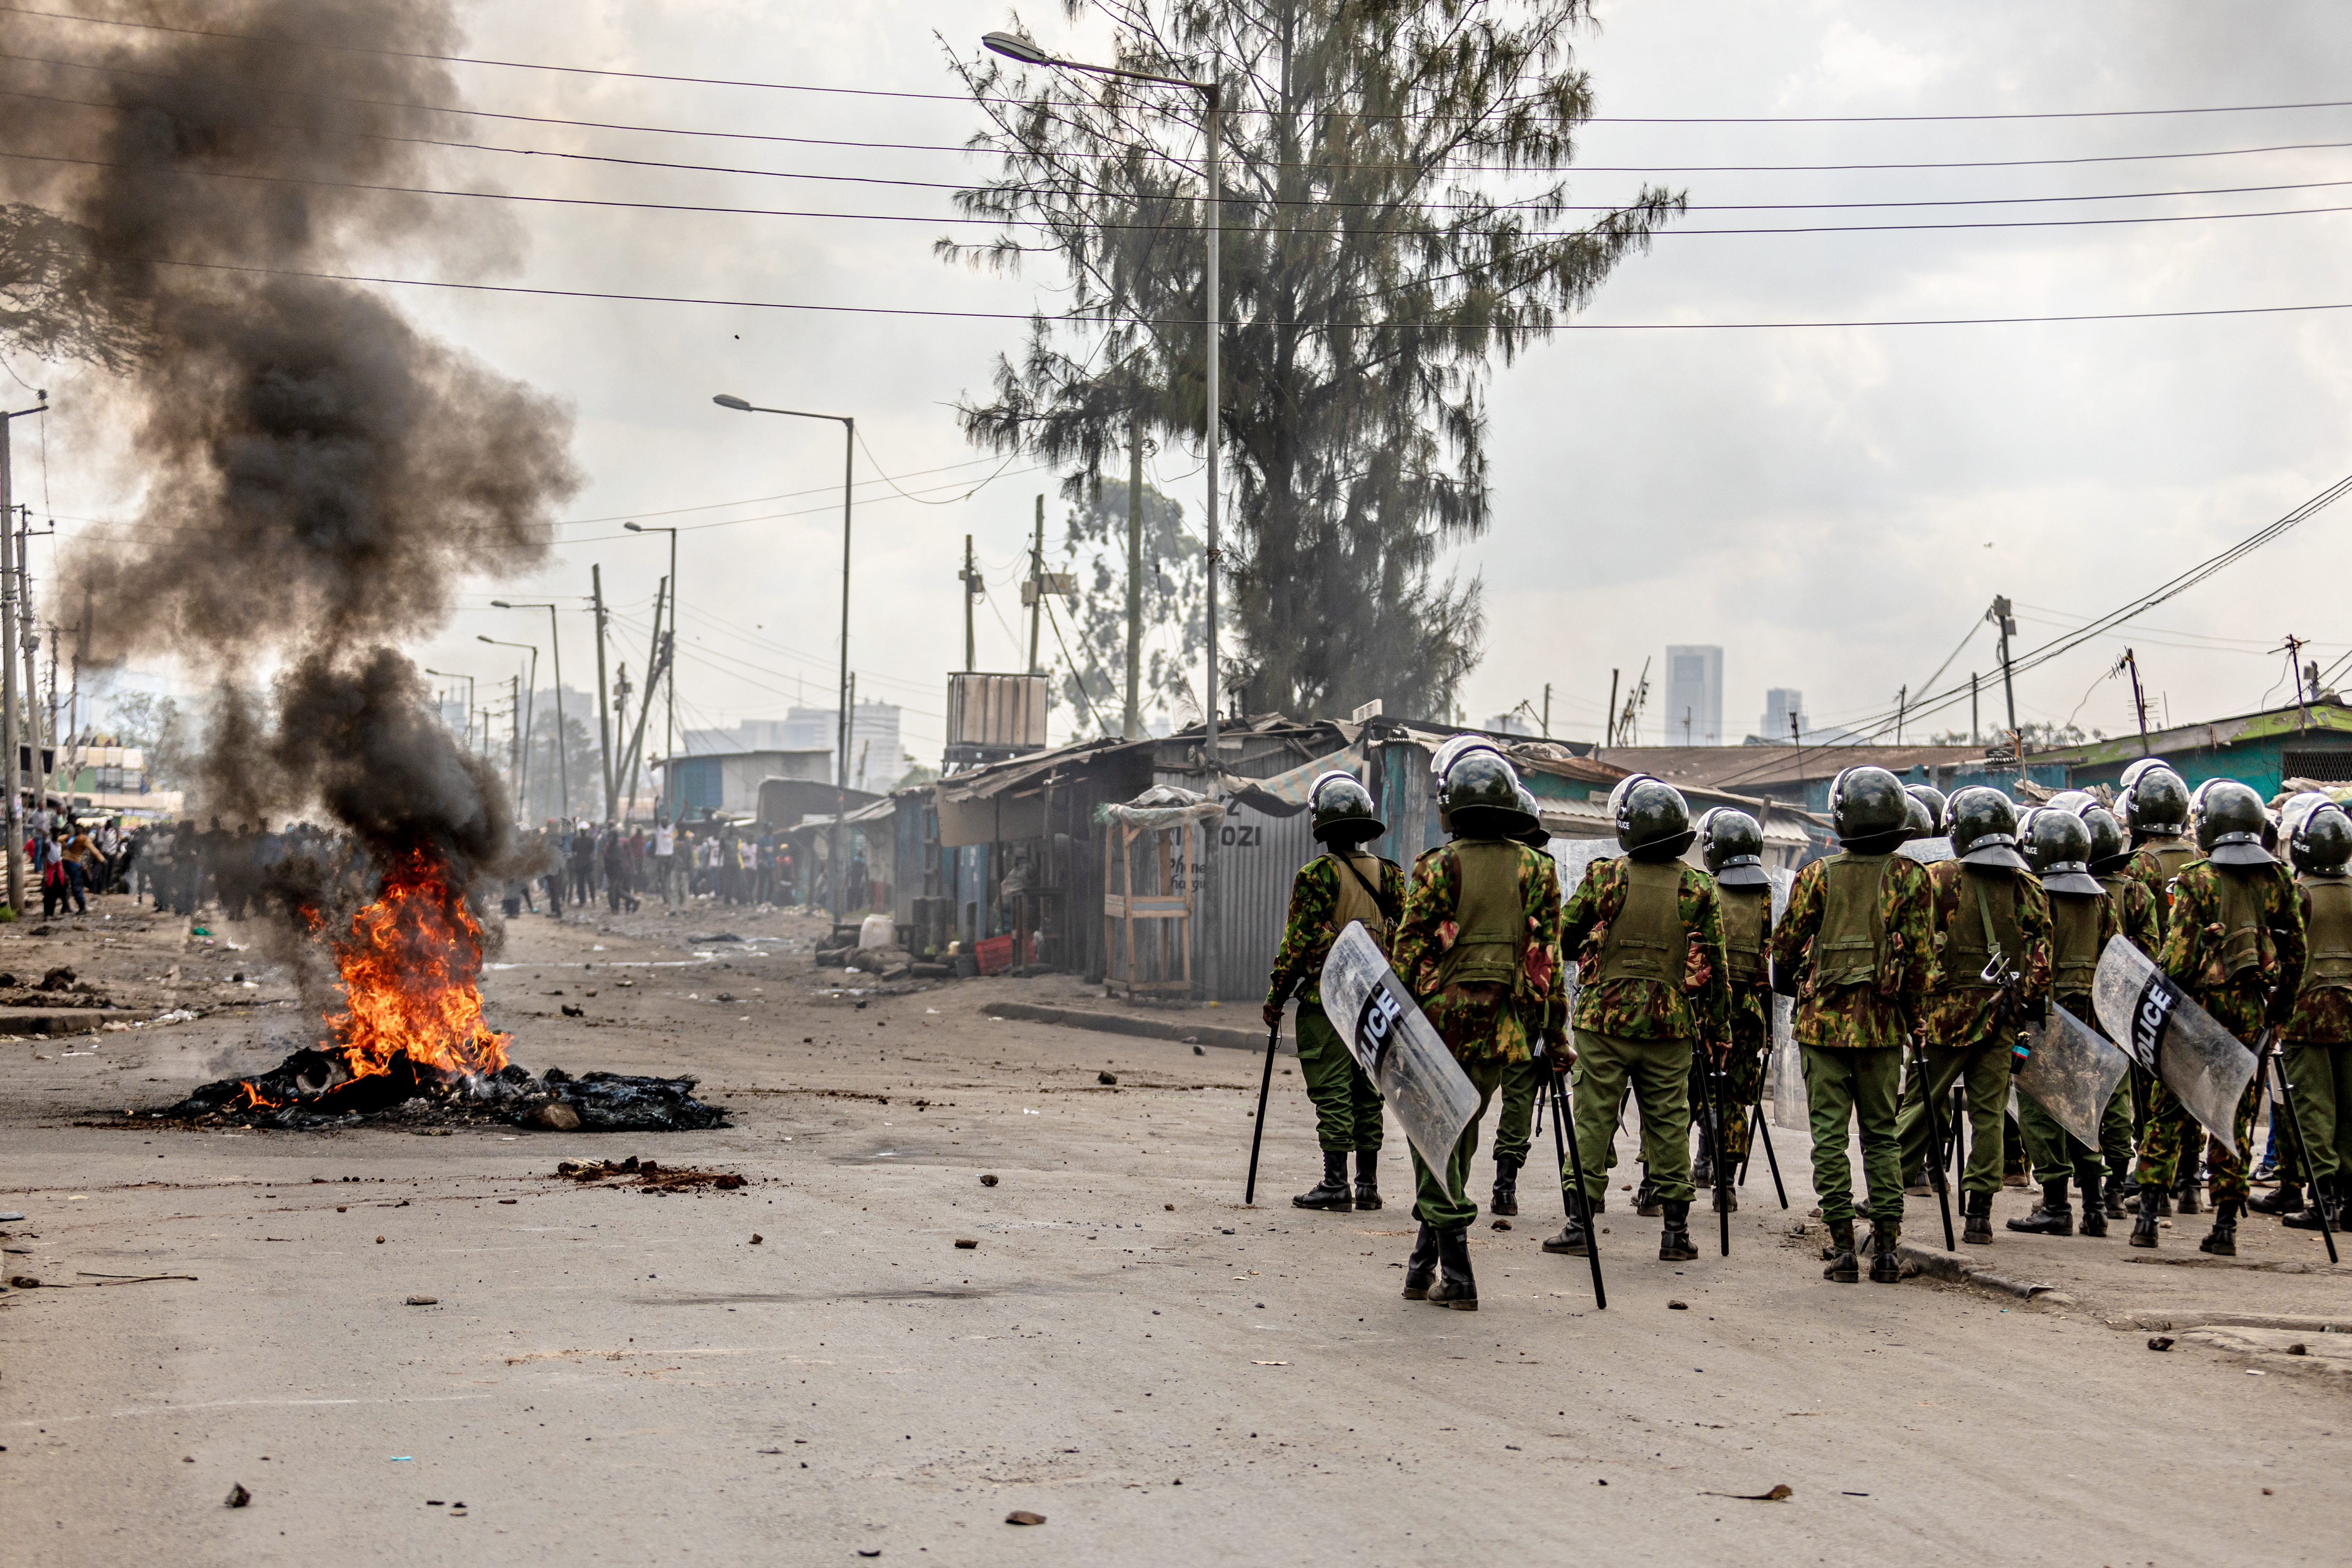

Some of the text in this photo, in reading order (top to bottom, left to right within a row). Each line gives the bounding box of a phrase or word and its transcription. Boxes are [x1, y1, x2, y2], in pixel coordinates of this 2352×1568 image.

[1617, 819, 1630, 830] POLICE
[2023, 845, 2038, 855] POLICE
[2292, 840, 2311, 853] POLICE
[1361, 988, 1401, 1080] OLICE
